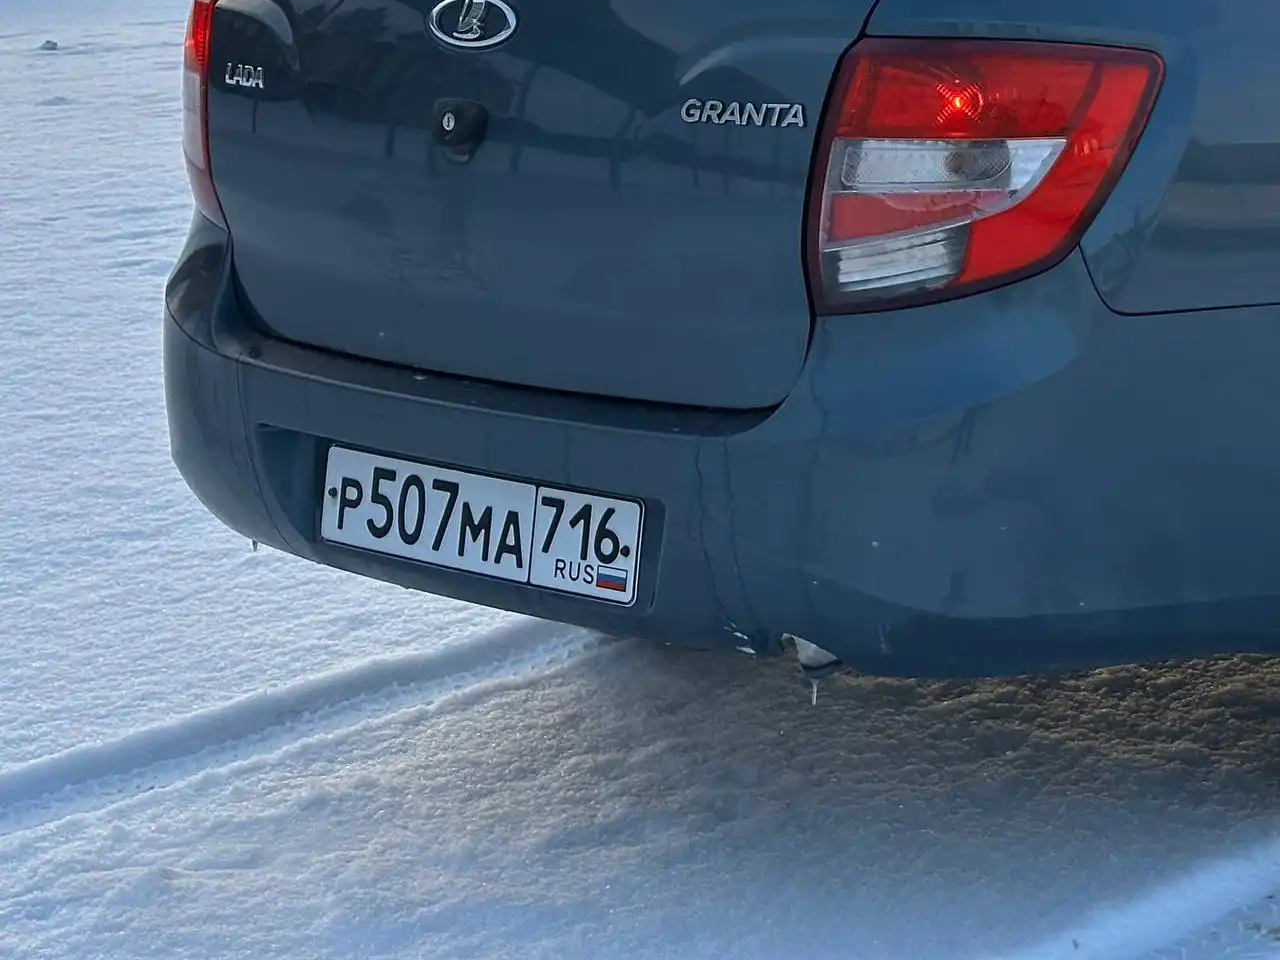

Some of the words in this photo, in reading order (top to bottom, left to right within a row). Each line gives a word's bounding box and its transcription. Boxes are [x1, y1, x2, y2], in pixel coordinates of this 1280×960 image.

[226, 63, 264, 88] LADA
[681, 99, 804, 127] GRANTA
[541, 497, 620, 564] 716
[554, 559, 594, 584] RUS
